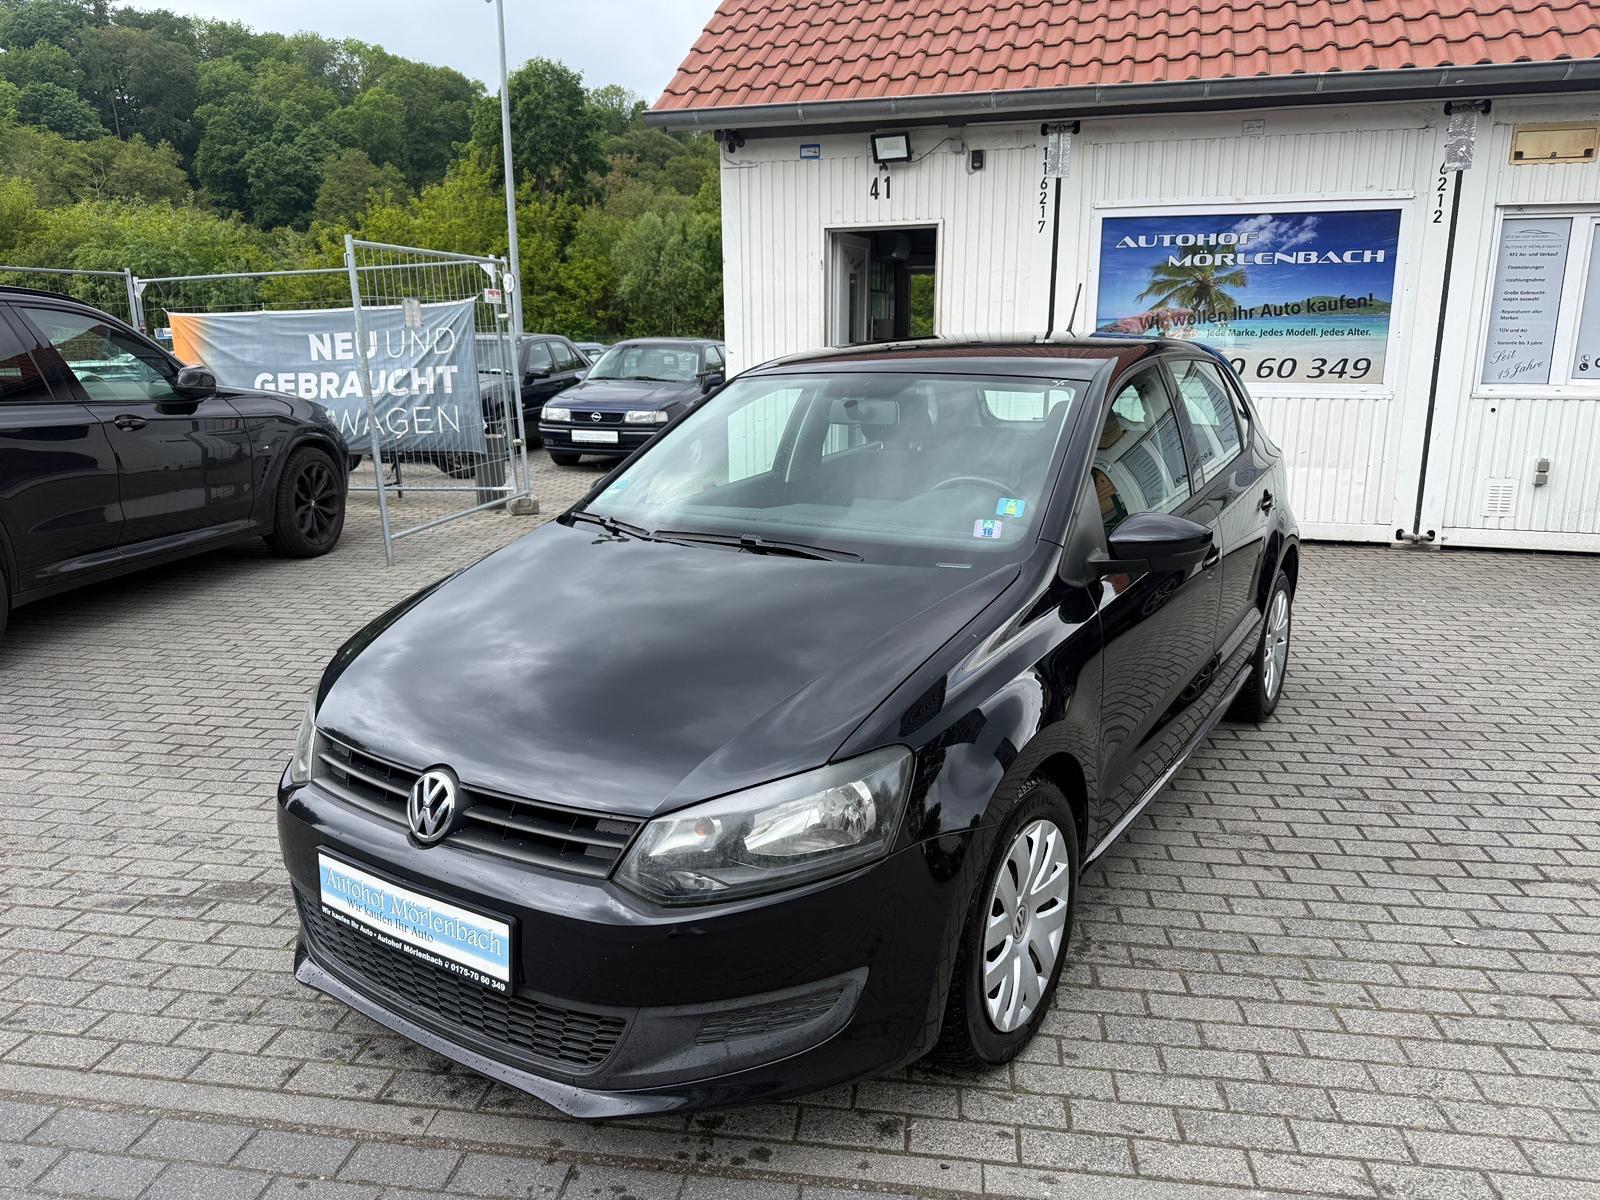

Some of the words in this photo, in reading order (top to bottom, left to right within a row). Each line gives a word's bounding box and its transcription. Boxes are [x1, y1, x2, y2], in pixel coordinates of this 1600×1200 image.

[870, 176, 891, 200] 41
[1115, 232, 1260, 249] AUTOHOF
[1168, 250, 1385, 268] MÖRLENBACH
[1140, 312, 1167, 331] Wir
[1171, 308, 1228, 327] wollen
[1233, 306, 1255, 321] Ihr
[1260, 303, 1301, 318] Auto
[1306, 292, 1373, 314] kaufen!
[308, 331, 377, 361] NEU
[386, 327, 455, 358] UND
[1228, 328, 1258, 337] Marke.
[1259, 328, 1284, 338] Jedes
[1286, 328, 1318, 337] Modell.
[1320, 328, 1345, 338] Jedes
[1347, 328, 1372, 337] Alter.
[254, 365, 458, 399] GEBRAUCHT
[1256, 357, 1298, 379] 60
[1306, 357, 1372, 379] 349
[1510, 358, 1544, 379] Jahre
[326, 866, 386, 910] Autohof
[390, 894, 501, 956] Mörlenbach
[346, 896, 361, 913] Wir
[364, 904, 393, 927] kaufen
[395, 918, 409, 934] Ihr
[411, 926, 434, 943] Auto
[321, 905, 331, 916] Wir
[360, 925, 373, 938] Auto
[378, 933, 402, 950] Autohof
[403, 943, 443, 967] Mörlenbach
[450, 963, 479, 981] 0175-70
[480, 975, 490, 986] 60
[491, 979, 506, 992] 349
